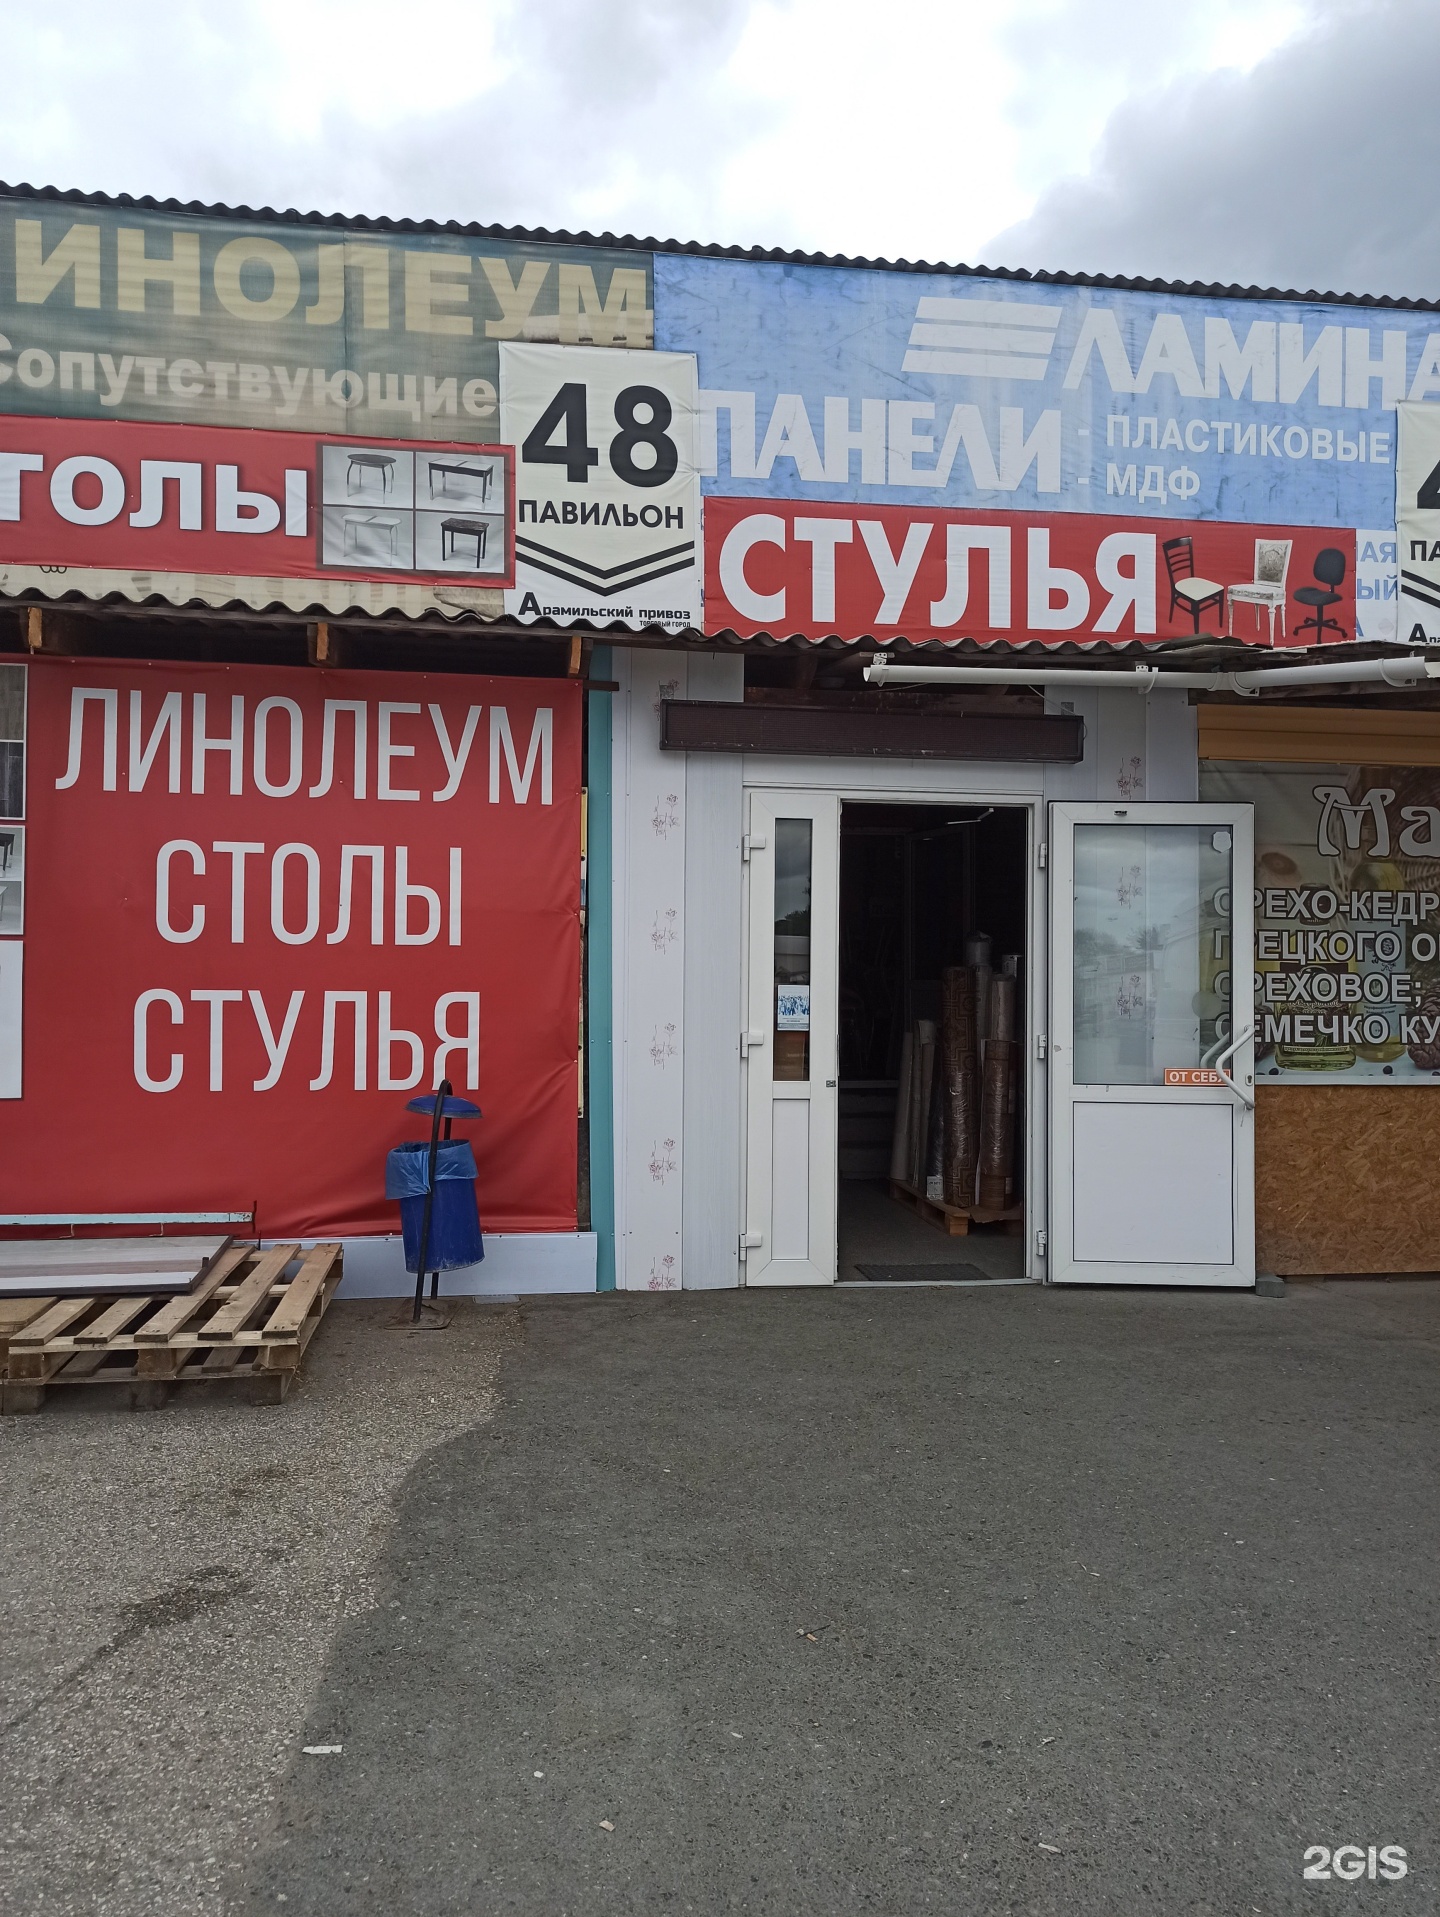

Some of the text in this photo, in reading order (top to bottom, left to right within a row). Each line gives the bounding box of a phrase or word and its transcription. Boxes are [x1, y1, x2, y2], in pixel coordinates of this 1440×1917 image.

[15, 219, 652, 348] ИНОЛЕУМ
[522, 382, 679, 488] 48
[699, 389, 1062, 494] ПАНЕЛИ
[1106, 413, 1390, 464] ПЛАСТИКОВЫЕ
[518, 499, 684, 530] ПАВИЛЬОН
[1106, 464, 1201, 503] МДФ
[719, 514, 1157, 635] СТУЛЬЯ
[1356, 541, 1397, 563] АЯ
[518, 592, 690, 620] Арамильский привоз
[55, 686, 554, 805] ЛИНОЛЕУМ
[1312, 785, 1440, 858] Ма
[155, 839, 462, 946] СТОЛЫ
[1213, 928, 1440, 966] ГЕЦКОГО О
[132, 988, 481, 1093] СТУЛЬЯ
[1169, 1071, 1188, 1083] ОТ
